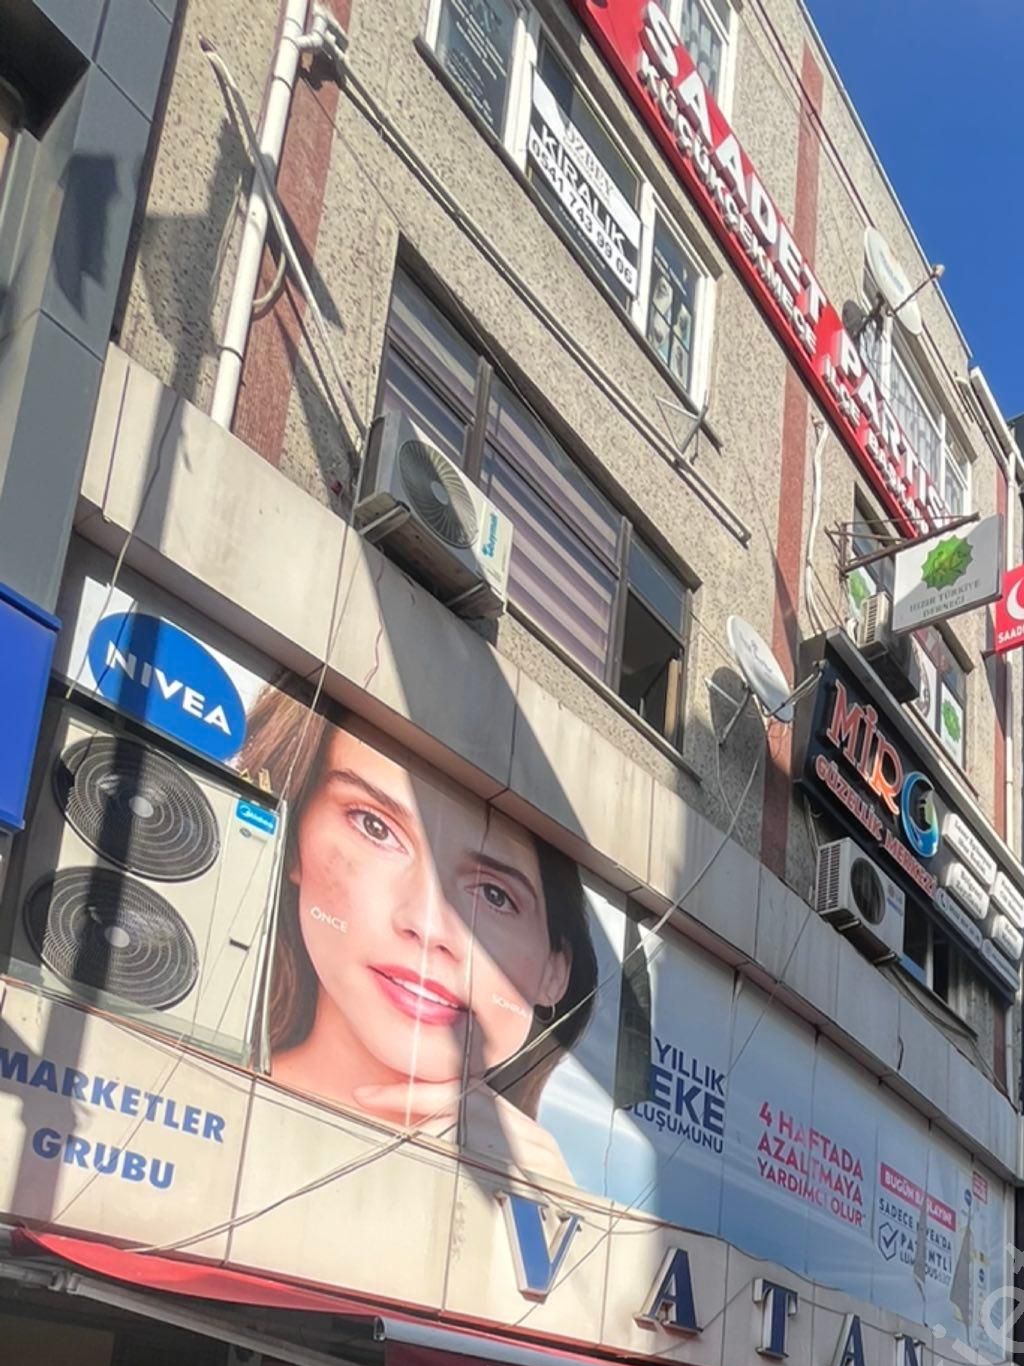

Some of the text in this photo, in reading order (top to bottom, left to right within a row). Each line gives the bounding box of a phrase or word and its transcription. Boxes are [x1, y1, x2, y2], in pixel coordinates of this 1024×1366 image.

[531, 136, 564, 193] 0541
[569, 190, 594, 237] 743
[540, 124, 628, 255] KIRALIK
[639, 48, 817, 354] KÜÇÜKÇEKMECE
[645, 2, 951, 528] SAADET PARTİS
[939, 578, 981, 602] TÜRKİYE
[106, 640, 233, 736] NIVEA
[815, 753, 938, 900] GÜZELLİK MERKEZİ
[0, 1047, 226, 1143] MARKETLER
[649, 1064, 725, 1137] EKE
[654, 1036, 725, 1097] YILLIK
[32, 1127, 176, 1189] GRUBU
[625, 1102, 724, 1154] LUŞUMUNU
[759, 1101, 863, 1182] 4 HAFTADA
[758, 1130, 862, 1206] AZALTMAYA
[758, 1156, 828, 1210] YARDIMCI
[879, 1198, 952, 1251] SADECE NVEA'DA
